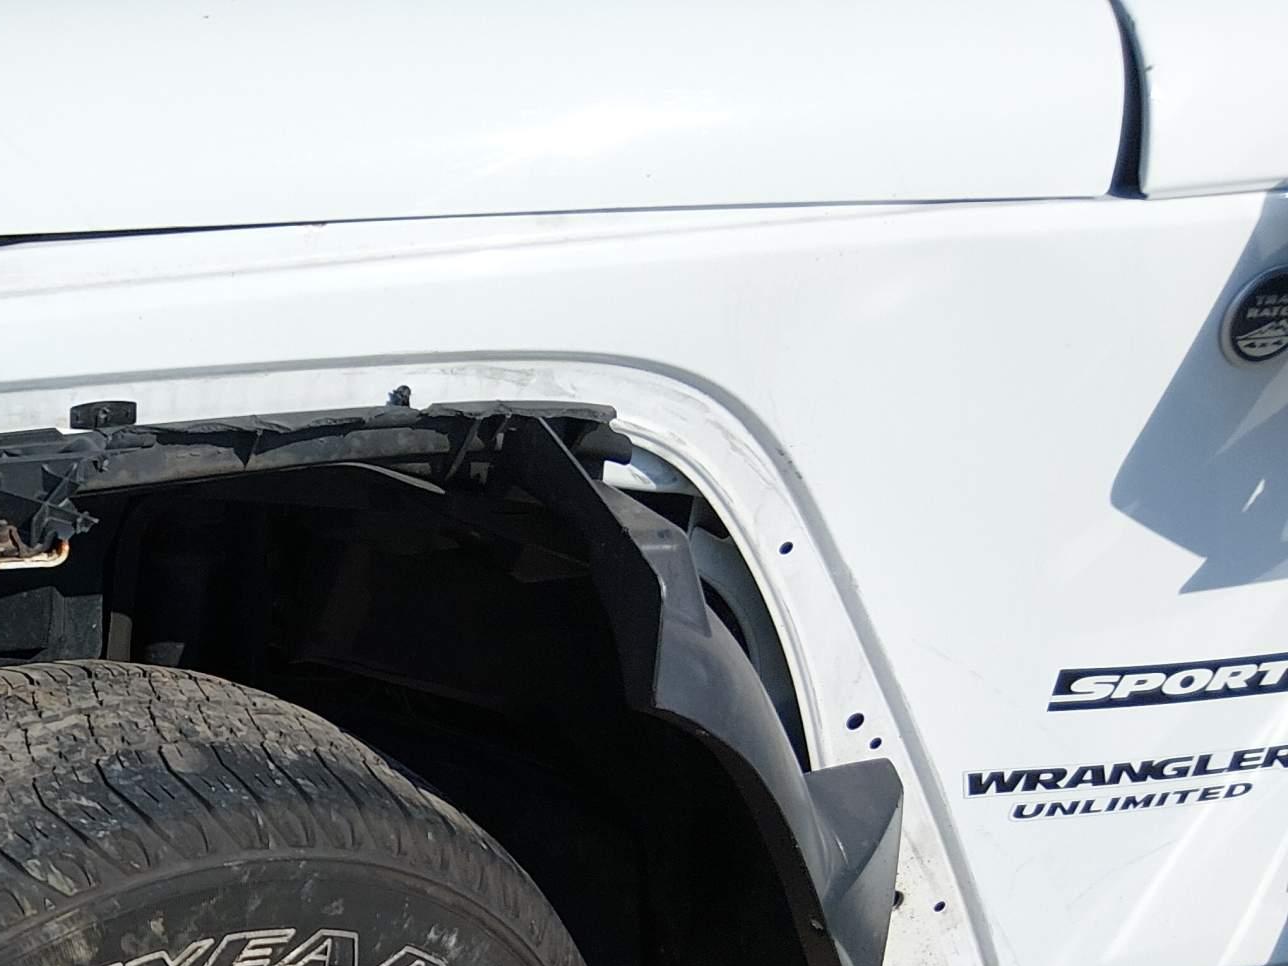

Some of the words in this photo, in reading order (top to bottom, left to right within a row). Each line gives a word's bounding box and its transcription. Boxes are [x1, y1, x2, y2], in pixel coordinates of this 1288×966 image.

[1064, 660, 1288, 700] SPORT
[967, 744, 1288, 796] WRANGLER
[1011, 782, 1254, 819] UNLIMITED
